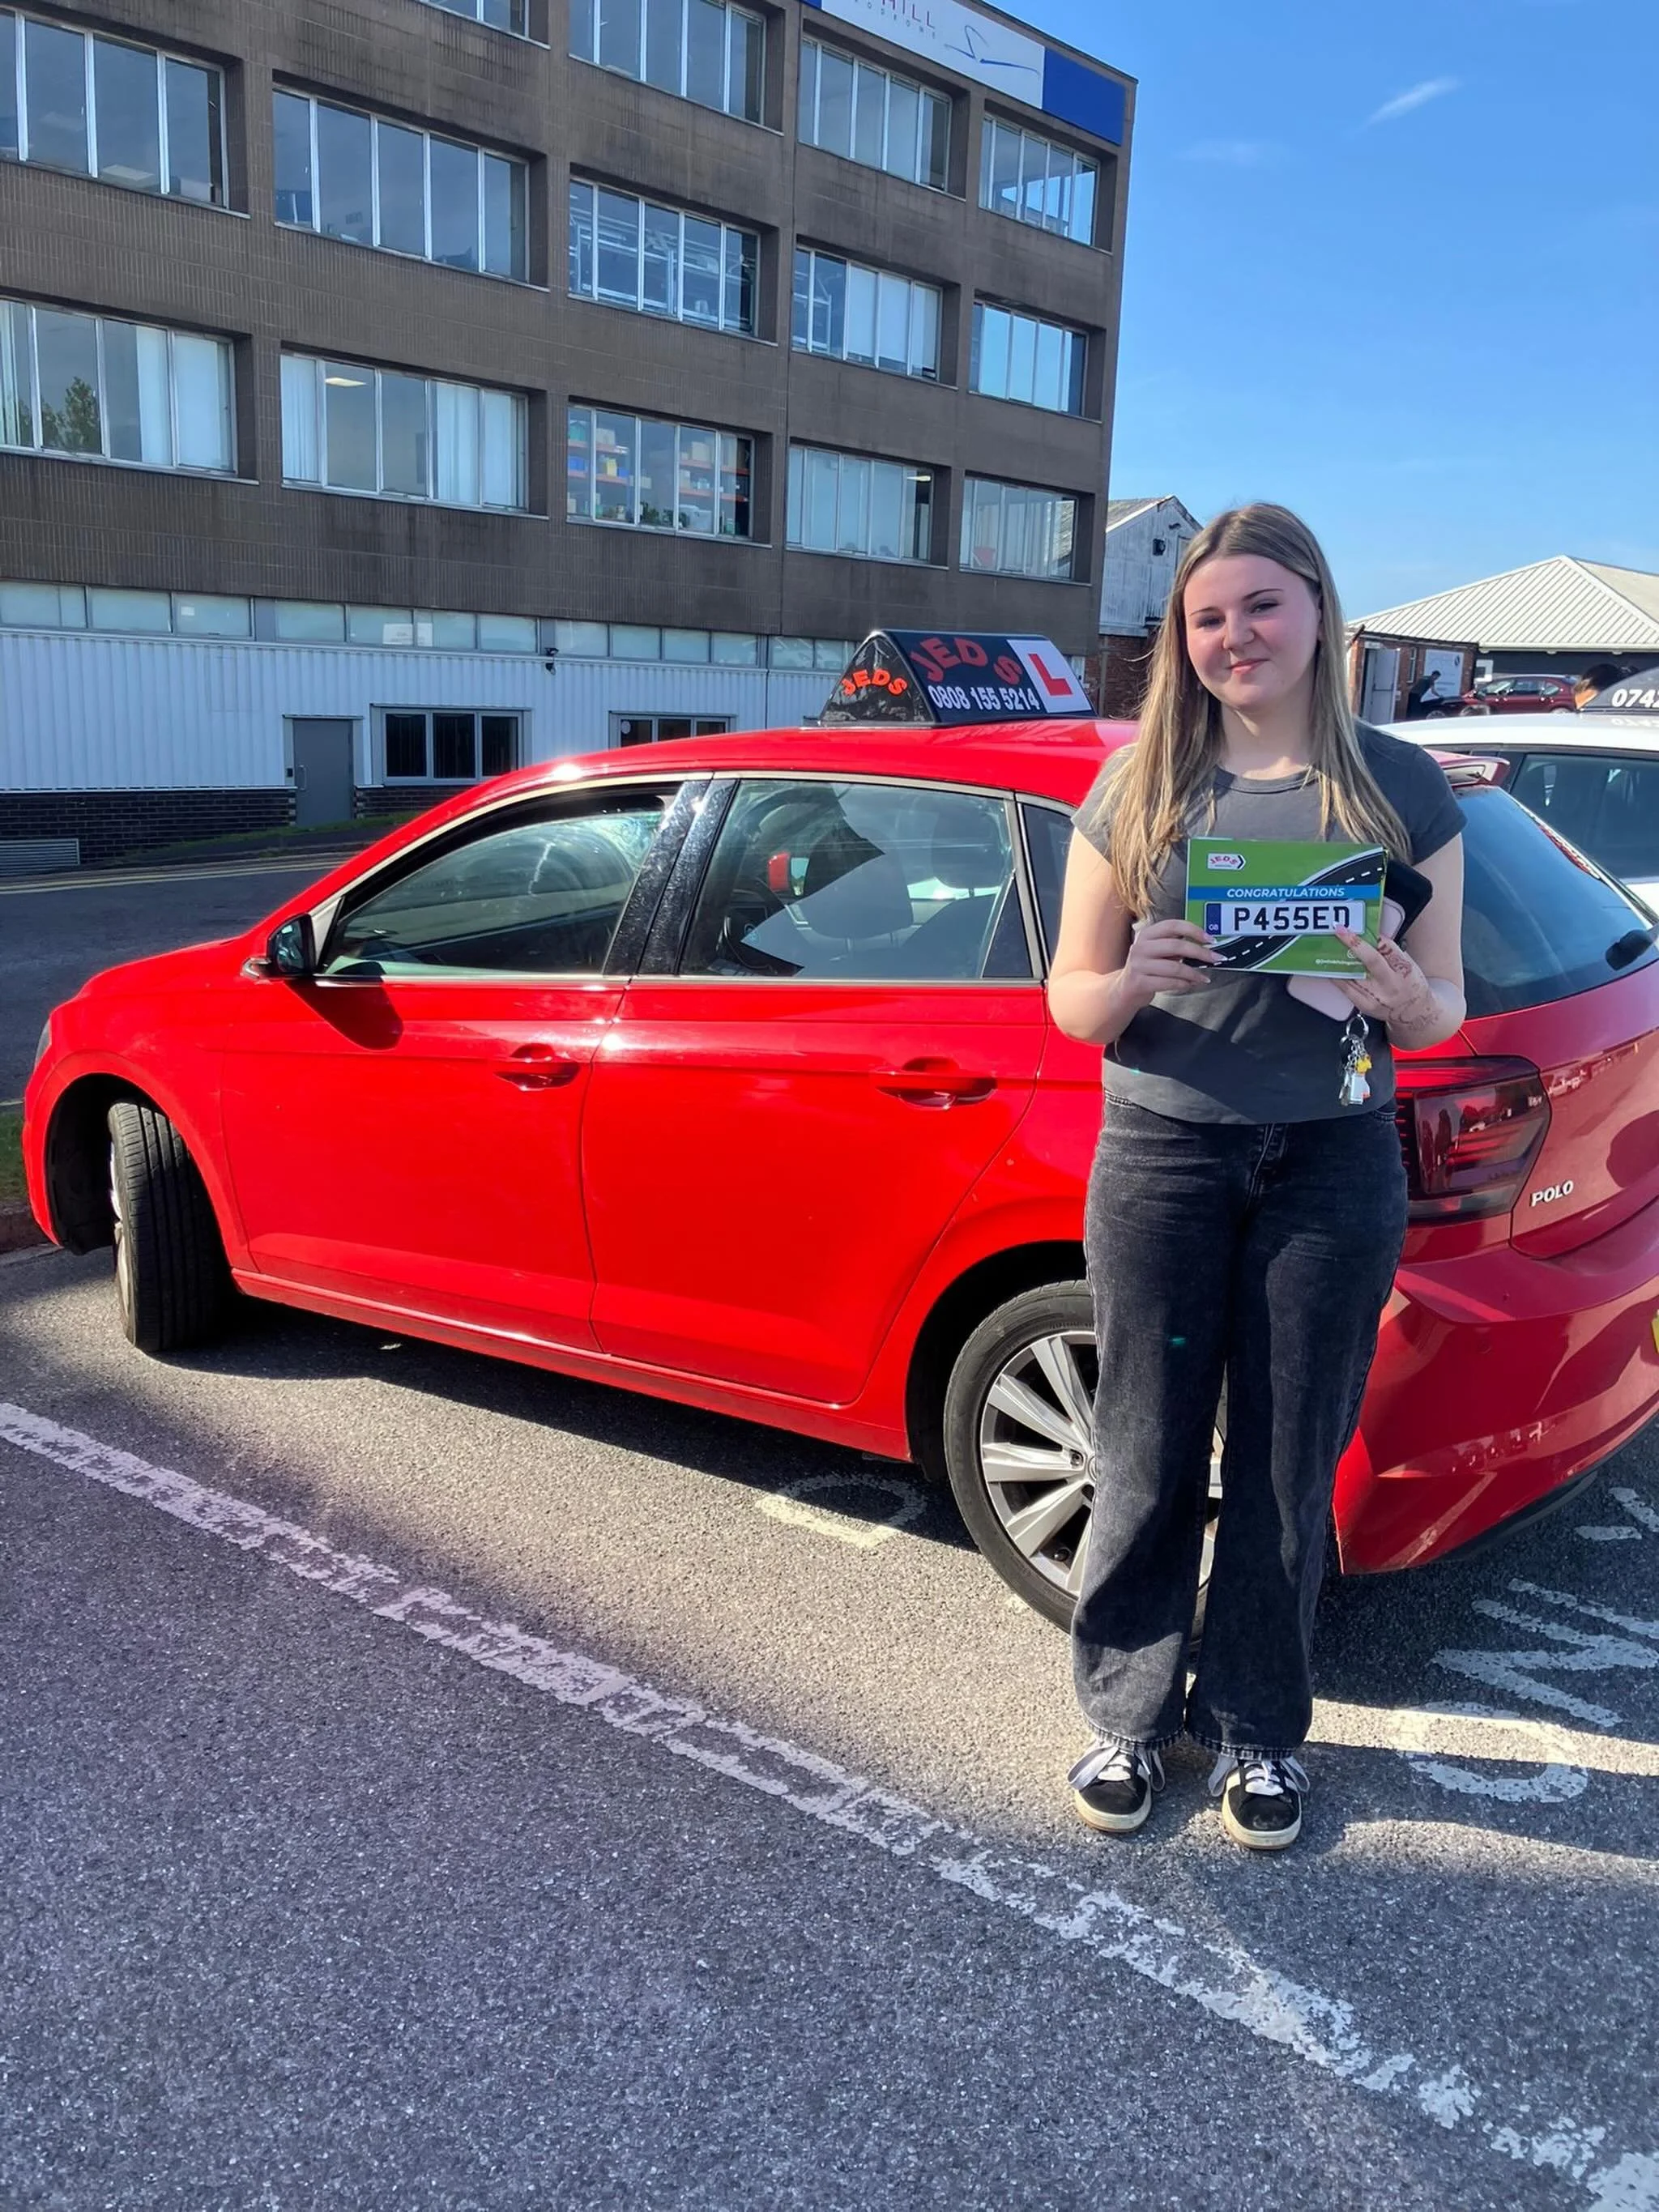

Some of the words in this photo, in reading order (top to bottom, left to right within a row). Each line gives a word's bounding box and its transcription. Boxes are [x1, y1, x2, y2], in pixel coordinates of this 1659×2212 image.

[909, 637, 1023, 685] JEDS
[1028, 653, 1073, 696] L
[841, 667, 908, 696] JEDS
[928, 685, 970, 710] 0808
[971, 686, 1001, 710] 155
[1001, 688, 1041, 710] 5214
[1226, 887, 1346, 898] CONGRATULATIONS
[1234, 906, 1350, 931] P455ED
[1530, 1180, 1574, 1207] POLO
